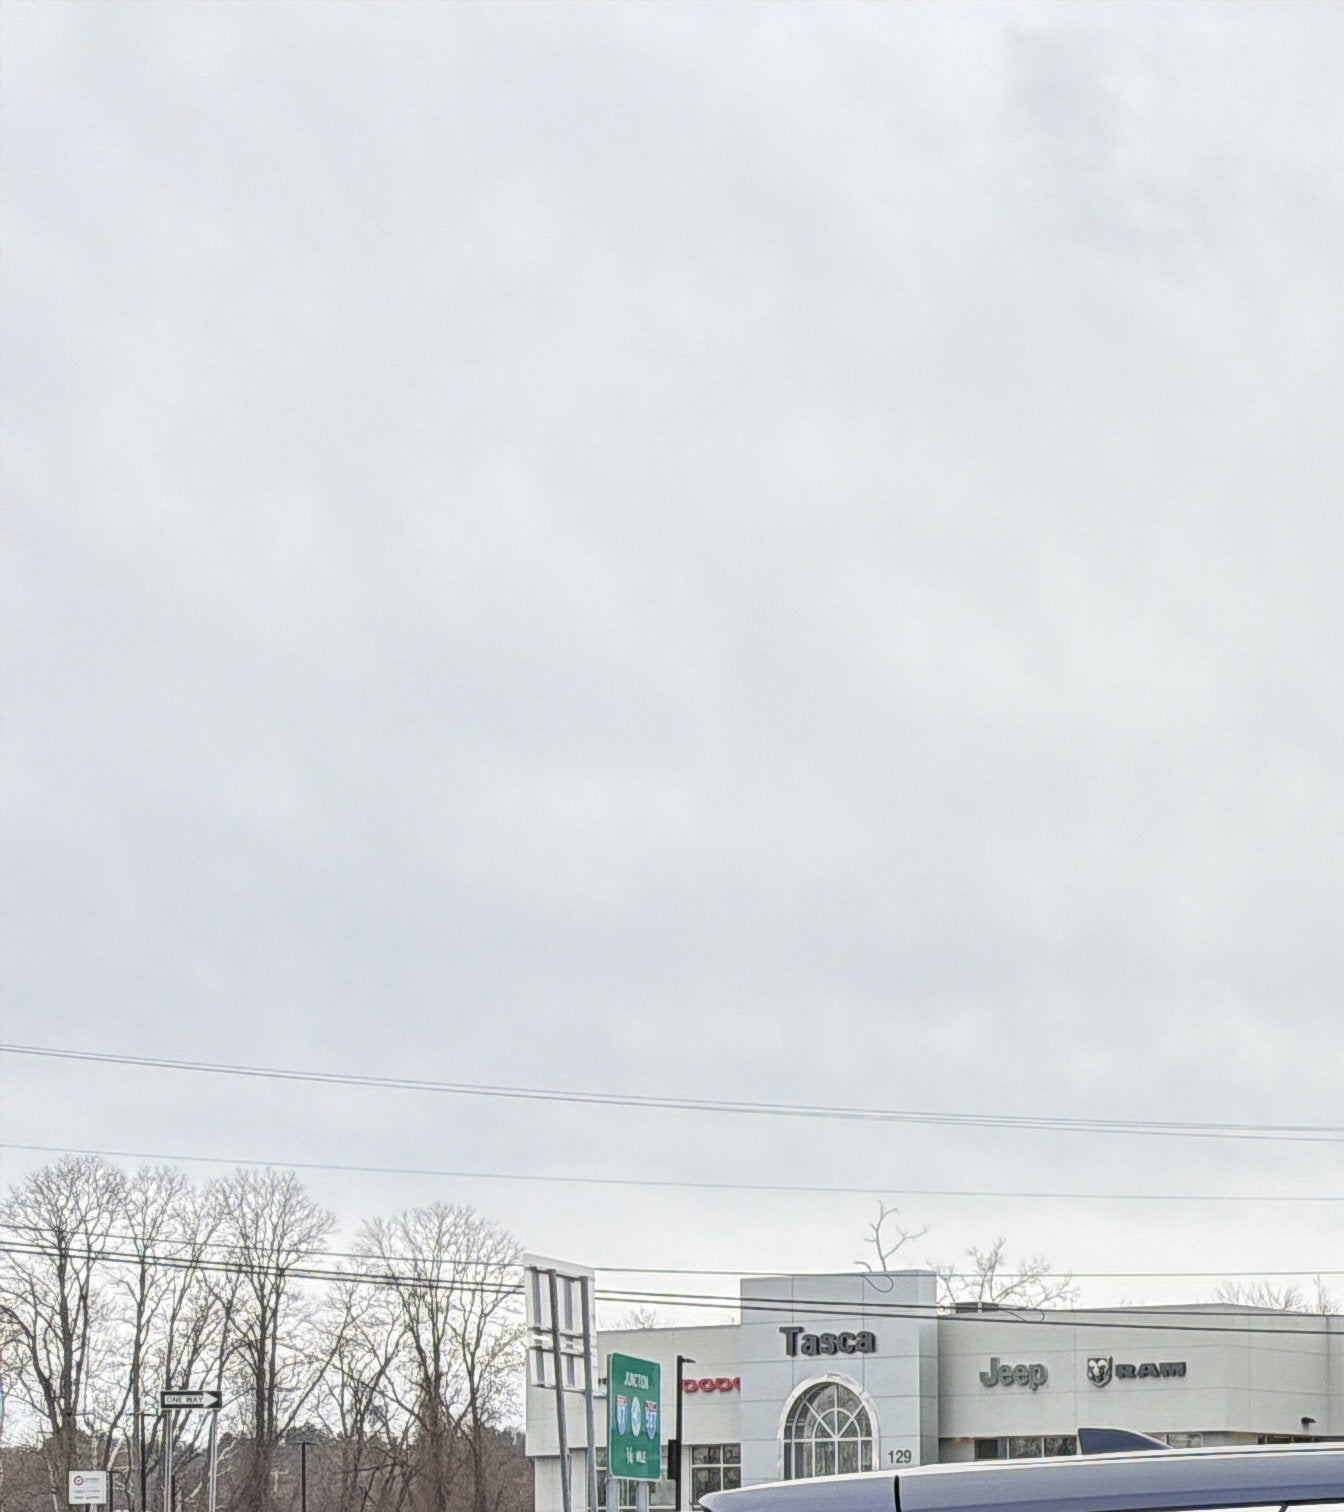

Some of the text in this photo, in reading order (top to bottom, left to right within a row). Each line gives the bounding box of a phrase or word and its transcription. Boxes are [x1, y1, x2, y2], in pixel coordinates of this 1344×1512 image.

[779, 1326, 876, 1357] Tasca
[979, 1357, 1048, 1391] Jeep
[1115, 1362, 1187, 1378] RAM
[185, 1396, 204, 1404] WAY
[888, 1450, 912, 1464] 129
